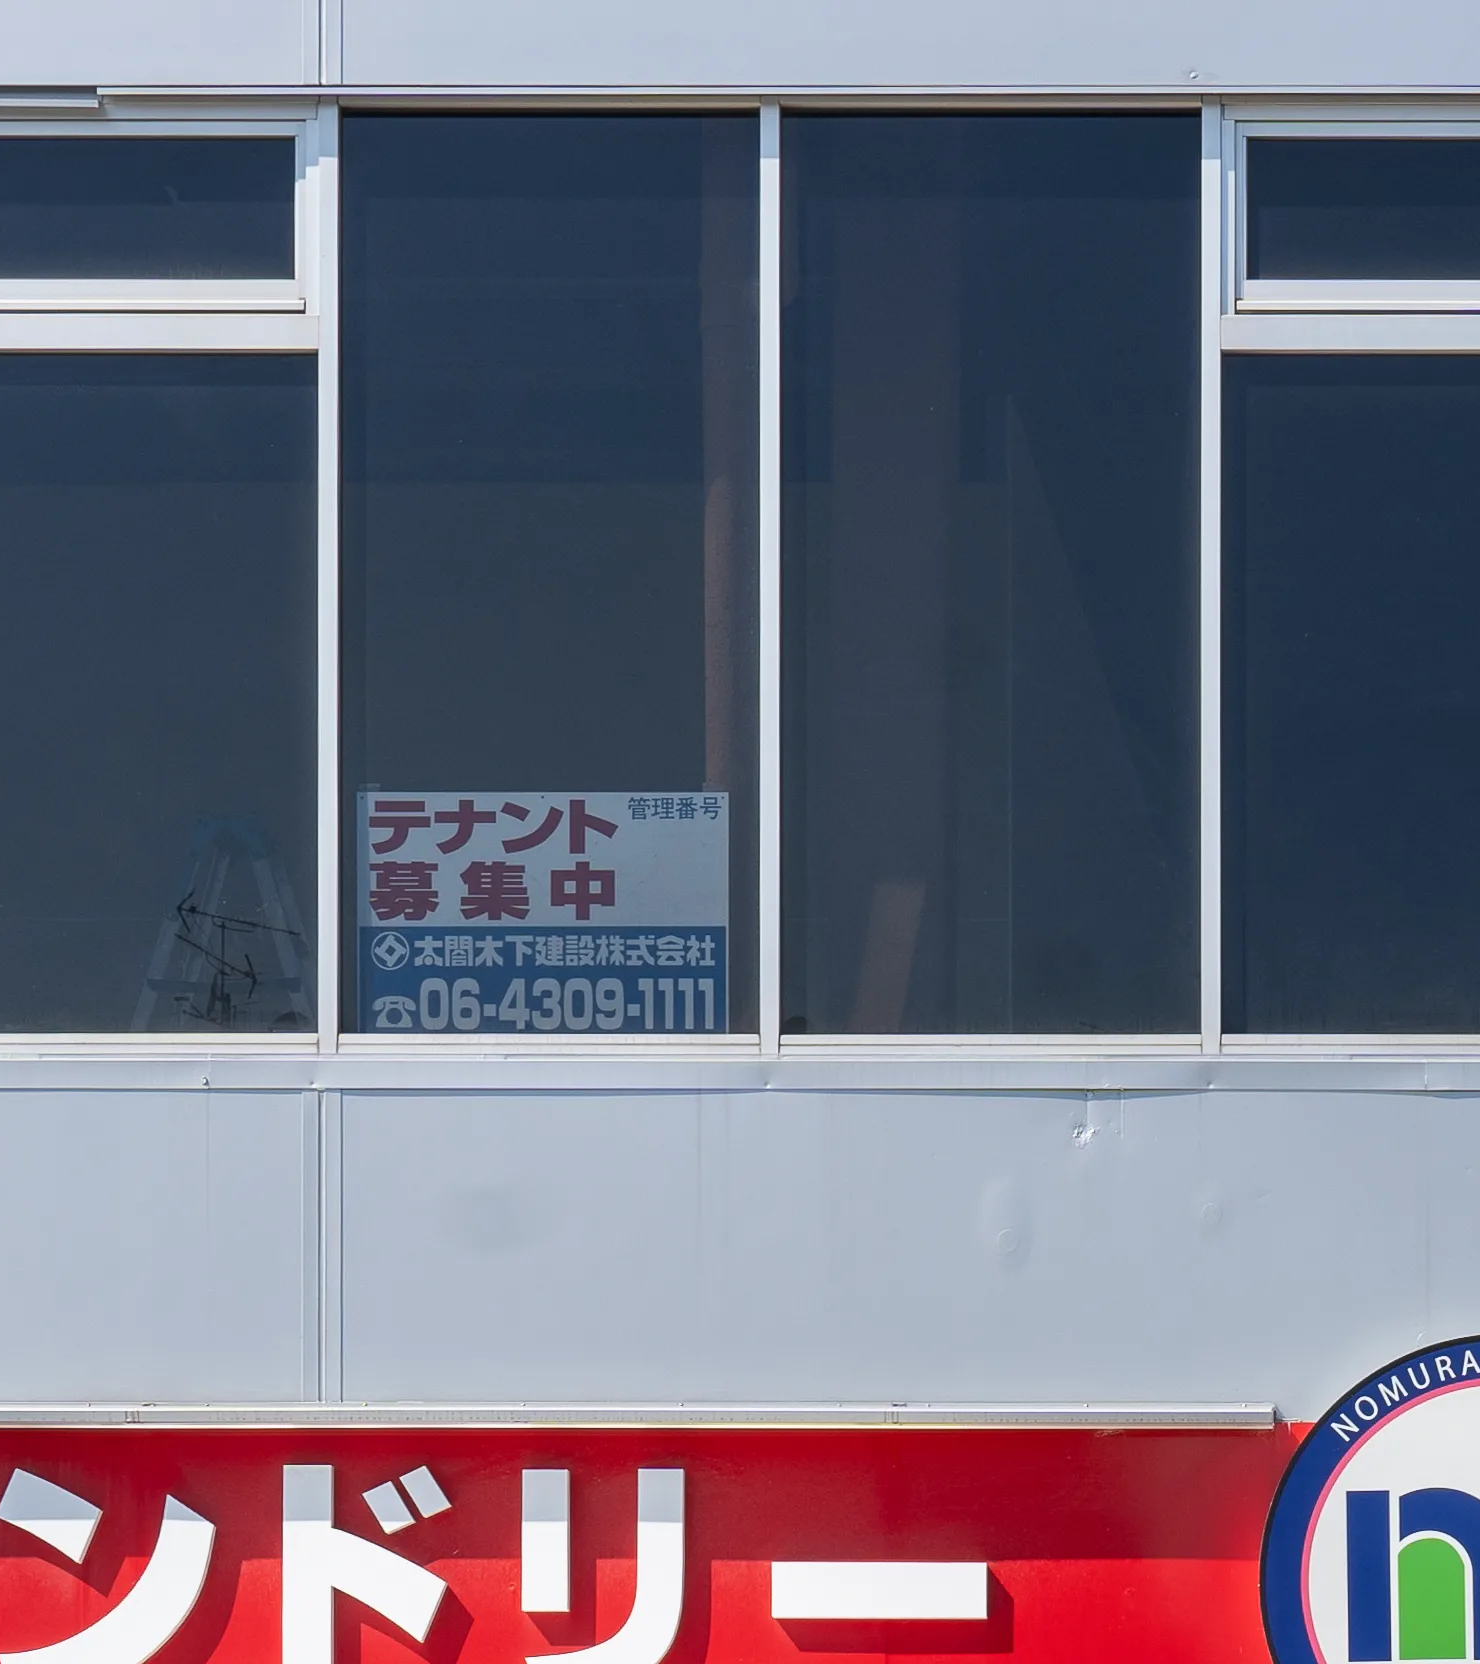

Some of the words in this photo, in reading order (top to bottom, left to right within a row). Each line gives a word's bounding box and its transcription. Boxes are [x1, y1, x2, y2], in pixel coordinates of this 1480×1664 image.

[369, 799, 618, 855] テナント
[627, 797, 722, 820] 管理番号
[369, 861, 616, 921] 募集中
[414, 935, 716, 966] 太閤木下建設株式会社
[419, 977, 715, 1031] 06-4309-1111
